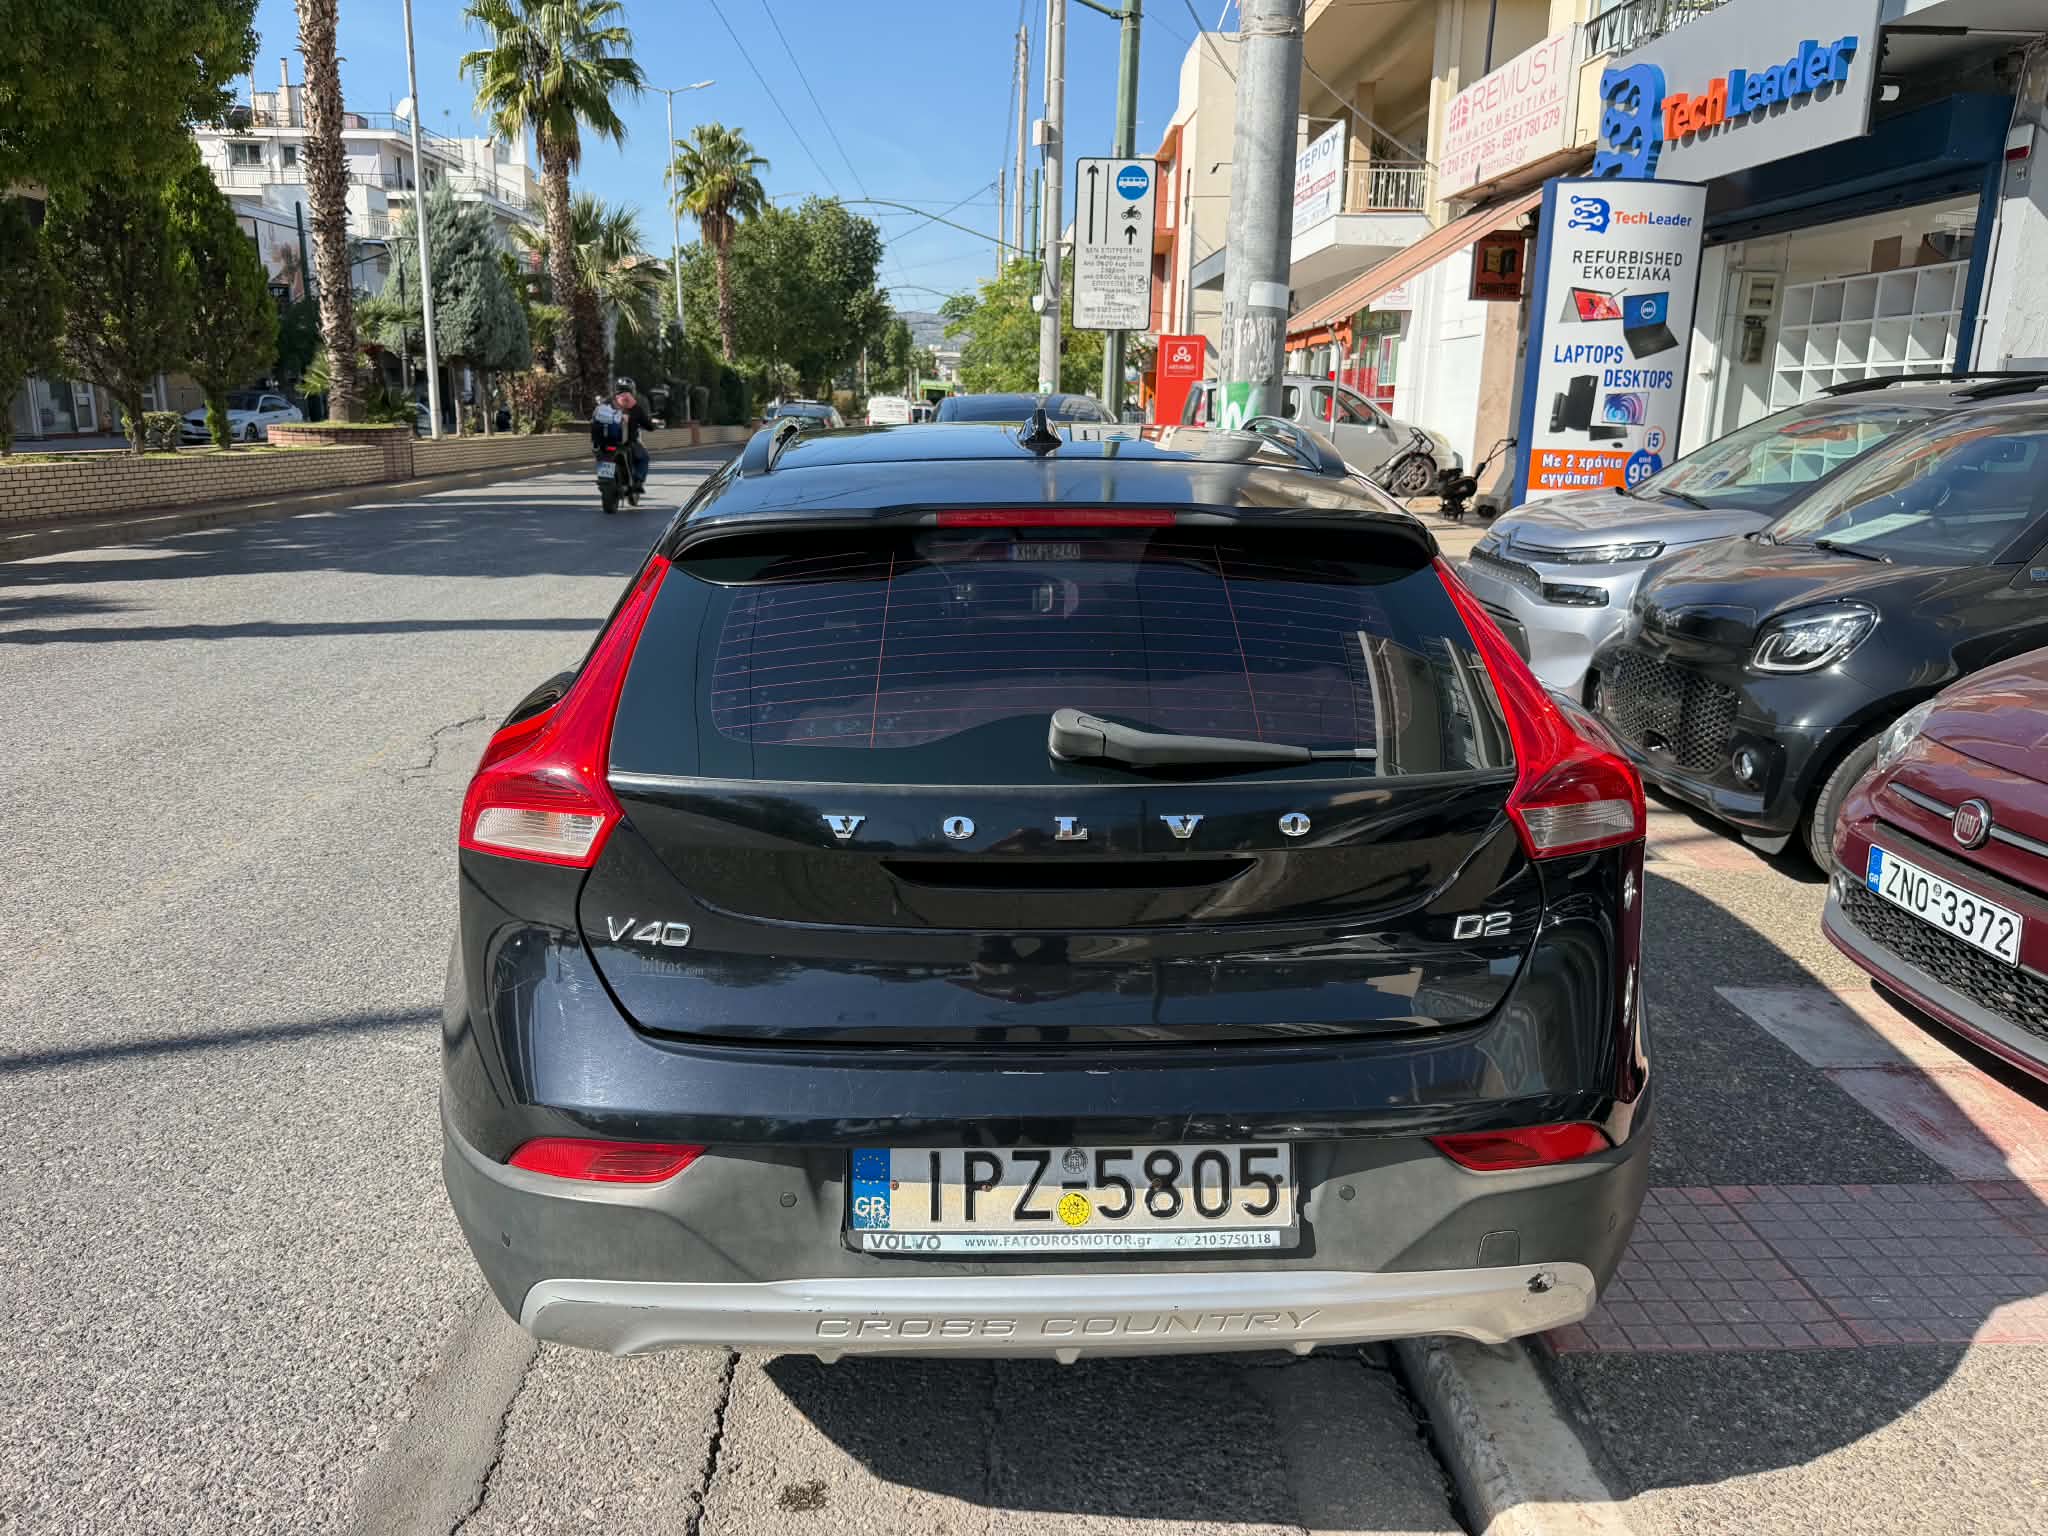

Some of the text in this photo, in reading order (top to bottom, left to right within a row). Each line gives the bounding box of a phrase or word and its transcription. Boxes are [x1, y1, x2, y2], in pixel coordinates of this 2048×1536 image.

[1472, 36, 1565, 118] REMUST
[1662, 36, 1858, 141] TechLeader
[1614, 210, 1692, 227] TechLeader
[1572, 250, 1683, 267] REFURBISHED
[1583, 266, 1671, 282] ΕΚΘΕΣΙΑΚΑ
[1554, 344, 1624, 364] LAPTOPS
[1604, 370, 1673, 390] DESKTOPS
[1647, 432, 1660, 448] i5
[1542, 454, 1561, 467] Με
[1566, 454, 1575, 468] 2
[822, 813, 1311, 840] VOLVO
[1957, 813, 1979, 836] FIAT
[1868, 872, 1880, 885] GR
[1886, 860, 2014, 957] ZNO-3372
[607, 916, 691, 947] V40
[1453, 912, 1512, 940] D2
[929, 1148, 1281, 1221] IPZ-5805
[854, 1196, 886, 1216] GR
[870, 1234, 942, 1250] VOLVO
[964, 1233, 1152, 1250] www.FATOUROSMOTOR.gr
[1194, 1233, 1271, 1246] 210 5750118
[815, 1309, 1322, 1338] CROSS COUNTRY
